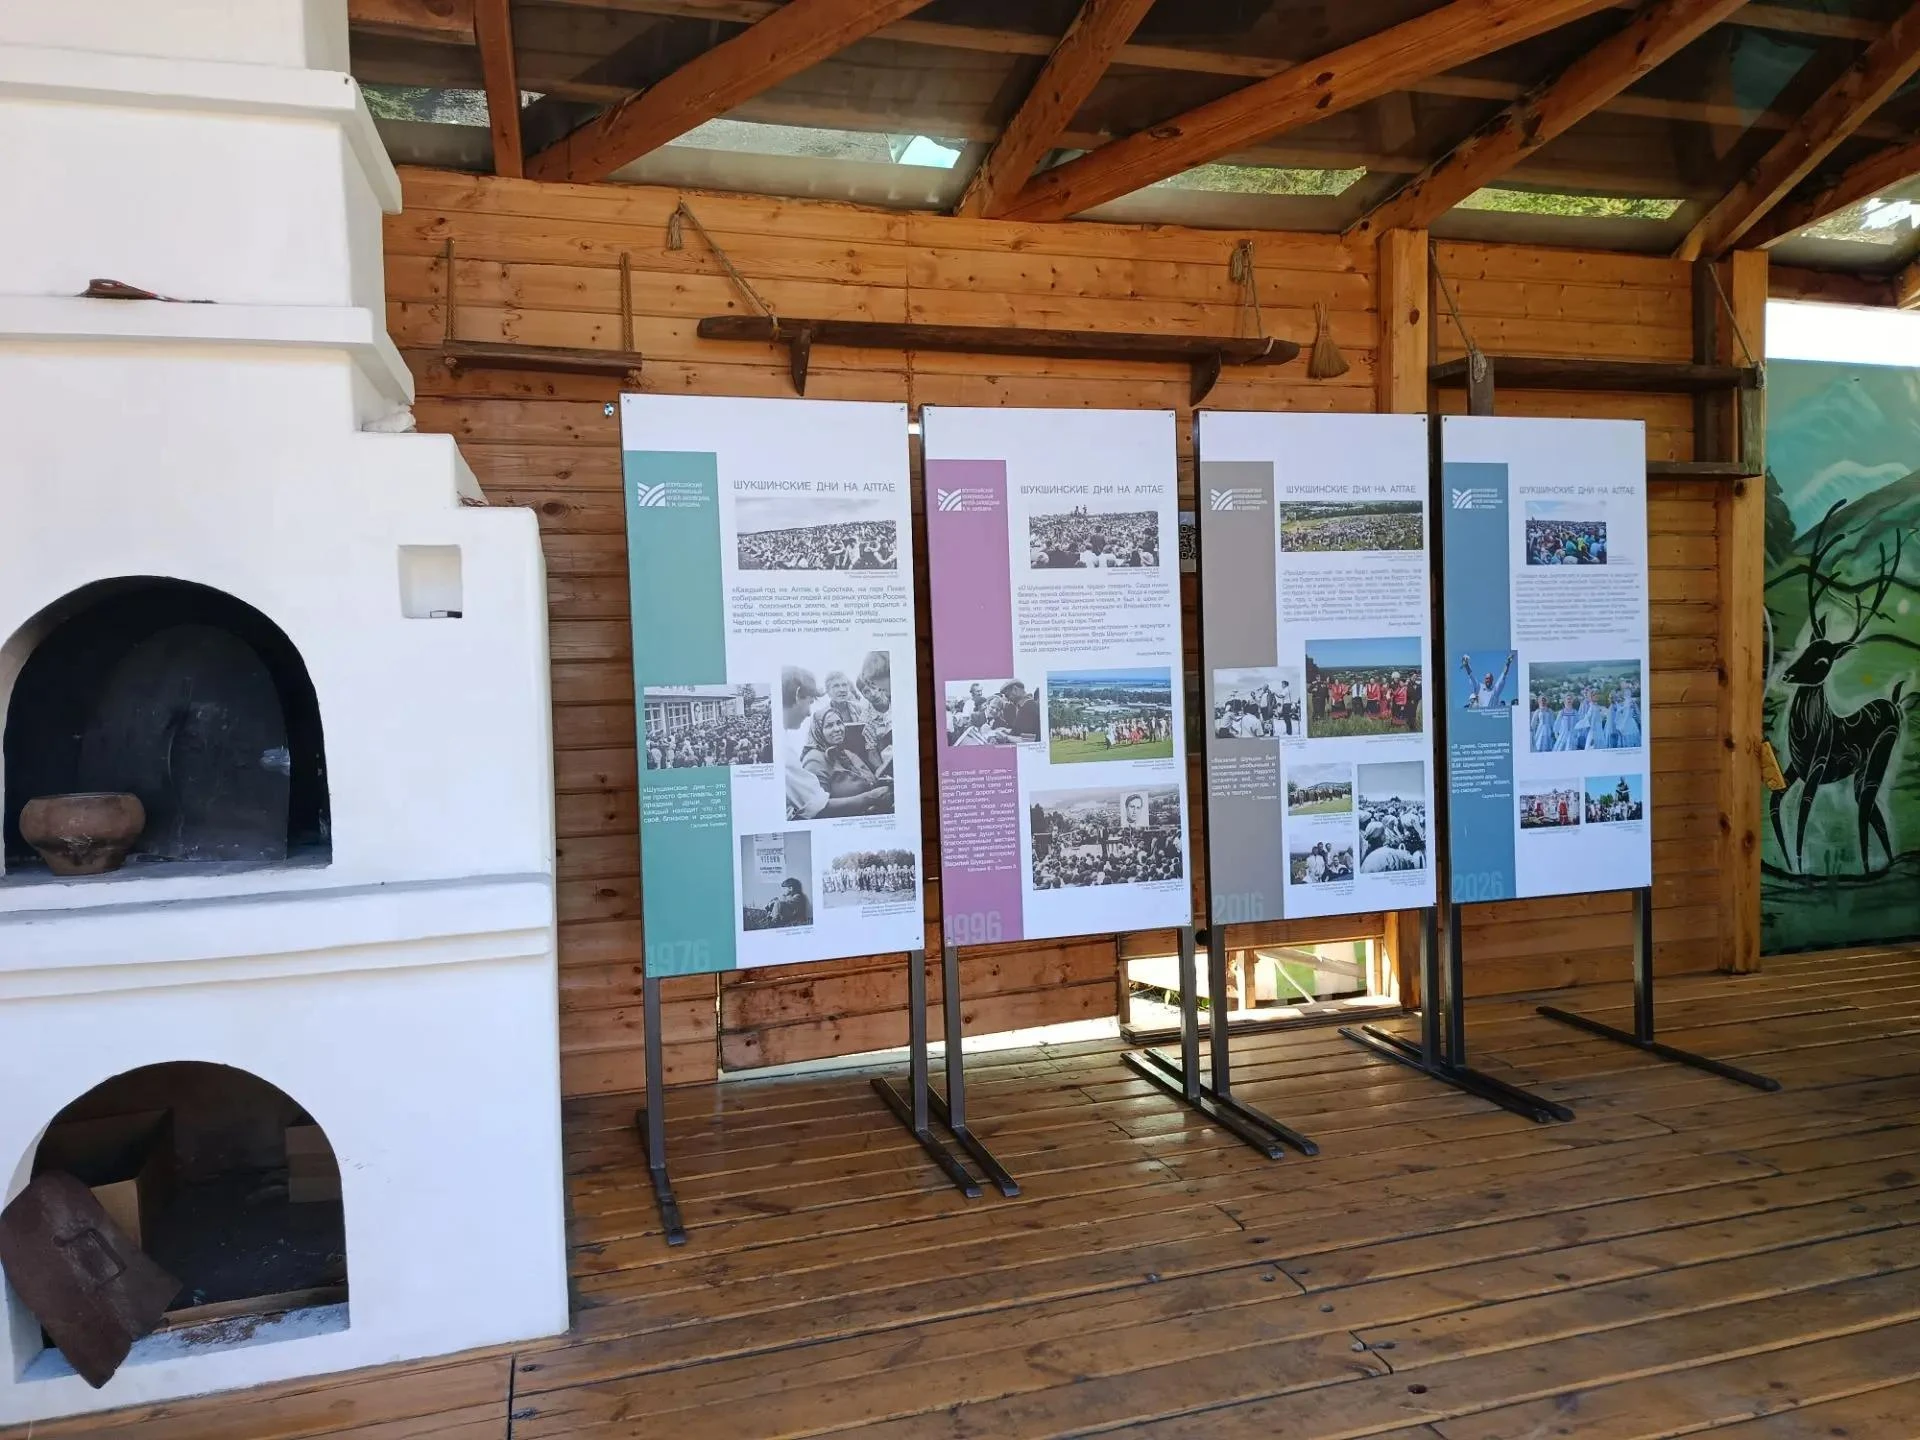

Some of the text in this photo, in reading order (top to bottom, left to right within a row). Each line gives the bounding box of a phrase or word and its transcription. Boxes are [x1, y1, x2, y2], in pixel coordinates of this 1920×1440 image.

[733, 479, 896, 492] ШУКШИНСКИЕ ДНИ НА АЛТАЕ
[1020, 484, 1164, 495] ШУКШИНСКИЕ ДНИ НА АЛТАЕ
[1286, 484, 1417, 494] ШУКШИНСКИЕ ДНИ НА АЛТАЕ
[1519, 486, 1637, 495] ШУКШИНСКИЕ ДНИ НА АЛТАЕ
[1453, 871, 1504, 902] 2026
[1212, 891, 1264, 923] 2016
[945, 910, 1003, 945] 1996
